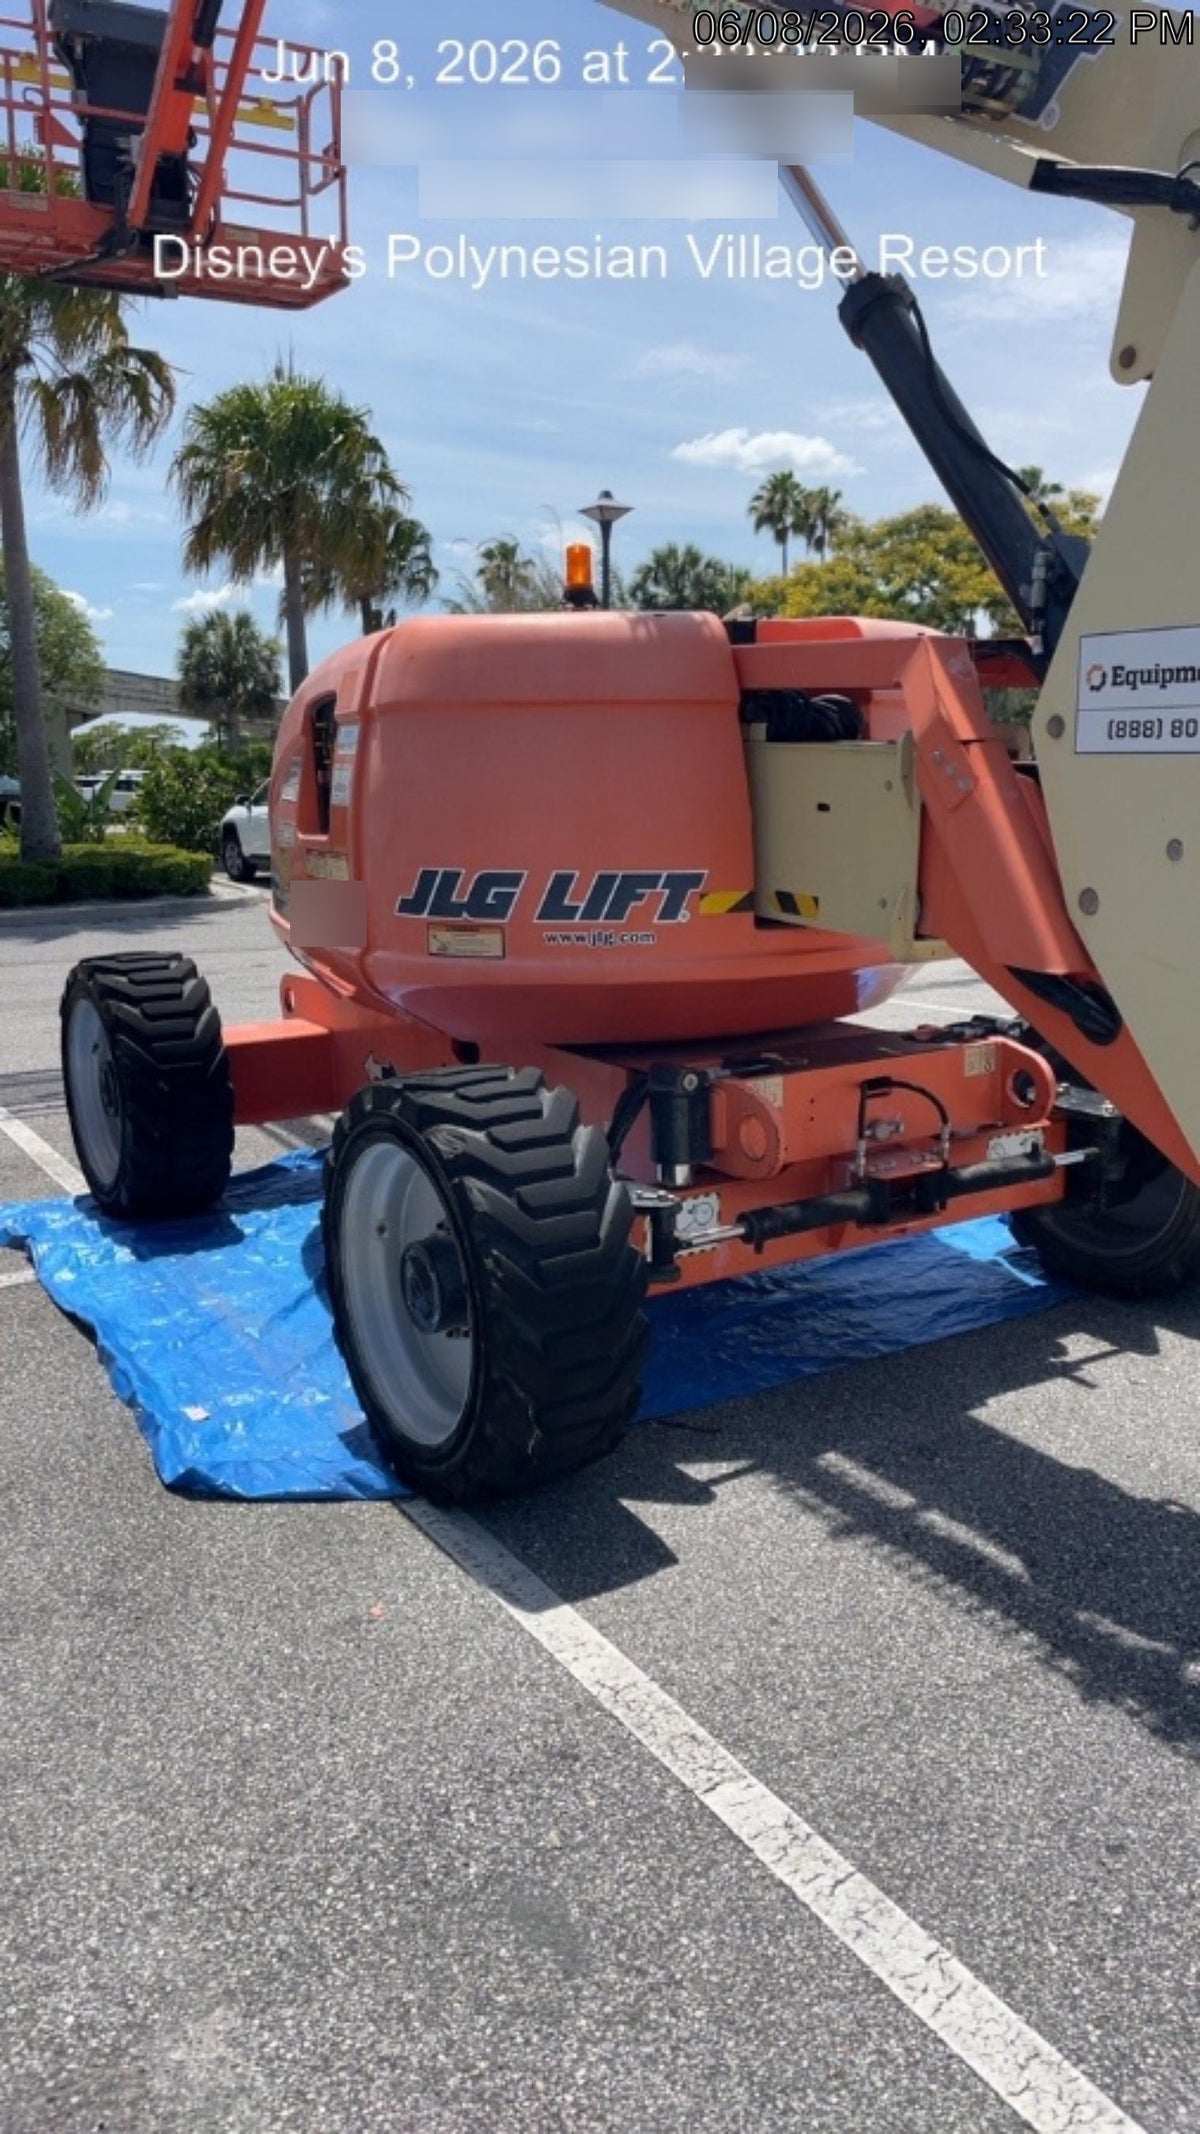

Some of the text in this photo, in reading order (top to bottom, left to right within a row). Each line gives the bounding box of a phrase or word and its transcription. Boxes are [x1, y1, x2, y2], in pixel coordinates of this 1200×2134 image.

[1107, 718, 1163, 740] (888)
[395, 867, 528, 923] JLG
[543, 929, 658, 947] www.jlg.com
